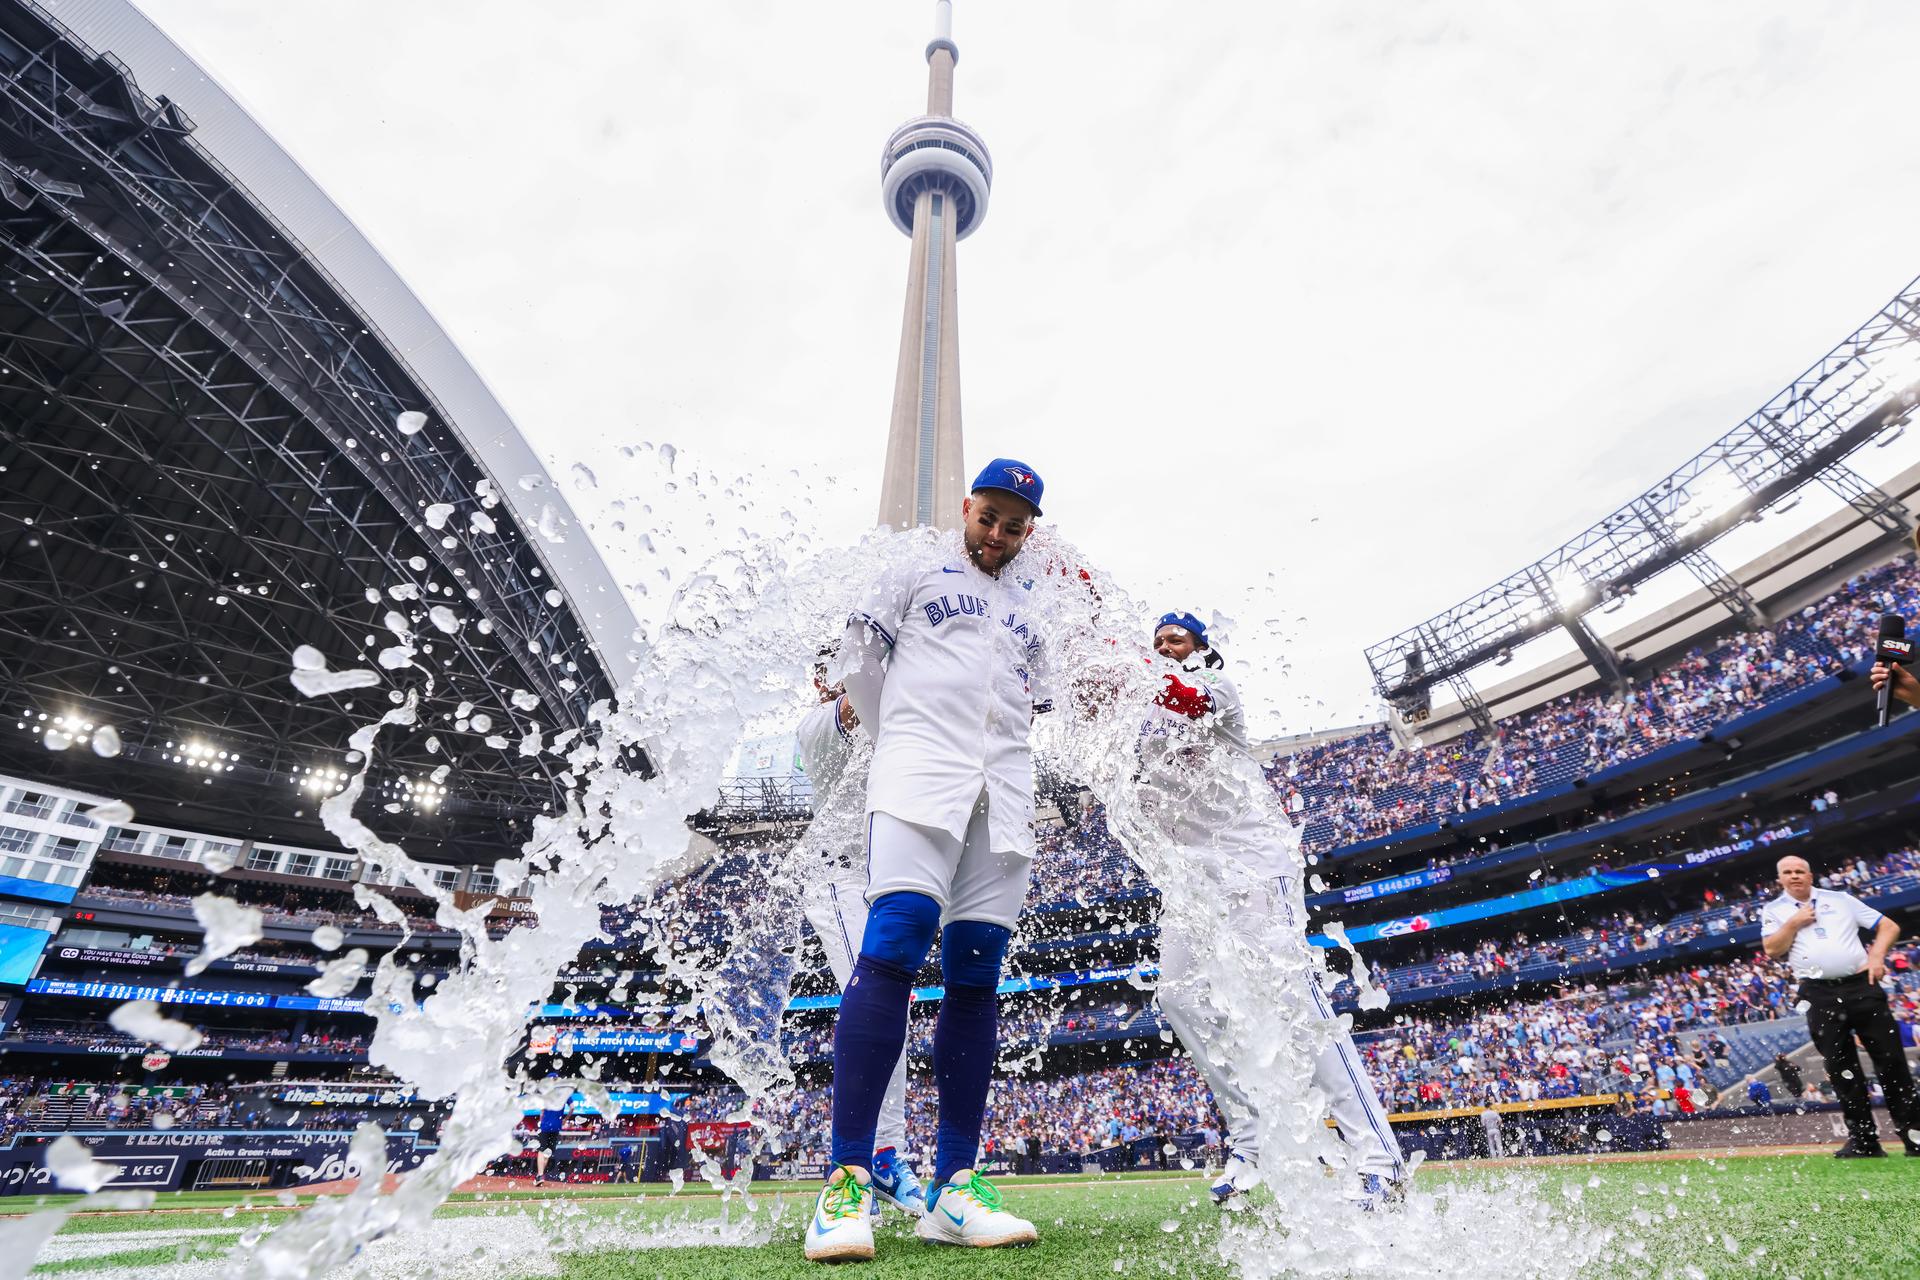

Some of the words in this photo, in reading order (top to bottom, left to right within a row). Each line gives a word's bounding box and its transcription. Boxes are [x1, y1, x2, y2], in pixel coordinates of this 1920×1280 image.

[1882, 639, 1911, 653] SN
[1685, 845, 1732, 864] lights
[1731, 839, 1755, 851] up
[233, 963, 254, 971] DAVE
[256, 964, 278, 972] STIEB
[87, 1045, 126, 1054] CANADA
[127, 1047, 147, 1055] DRY
[176, 1049, 223, 1057] BLEACHERS
[284, 1088, 369, 1103] theScore
[204, 1148, 235, 1156] Active
[131, 1165, 165, 1176] KEG
